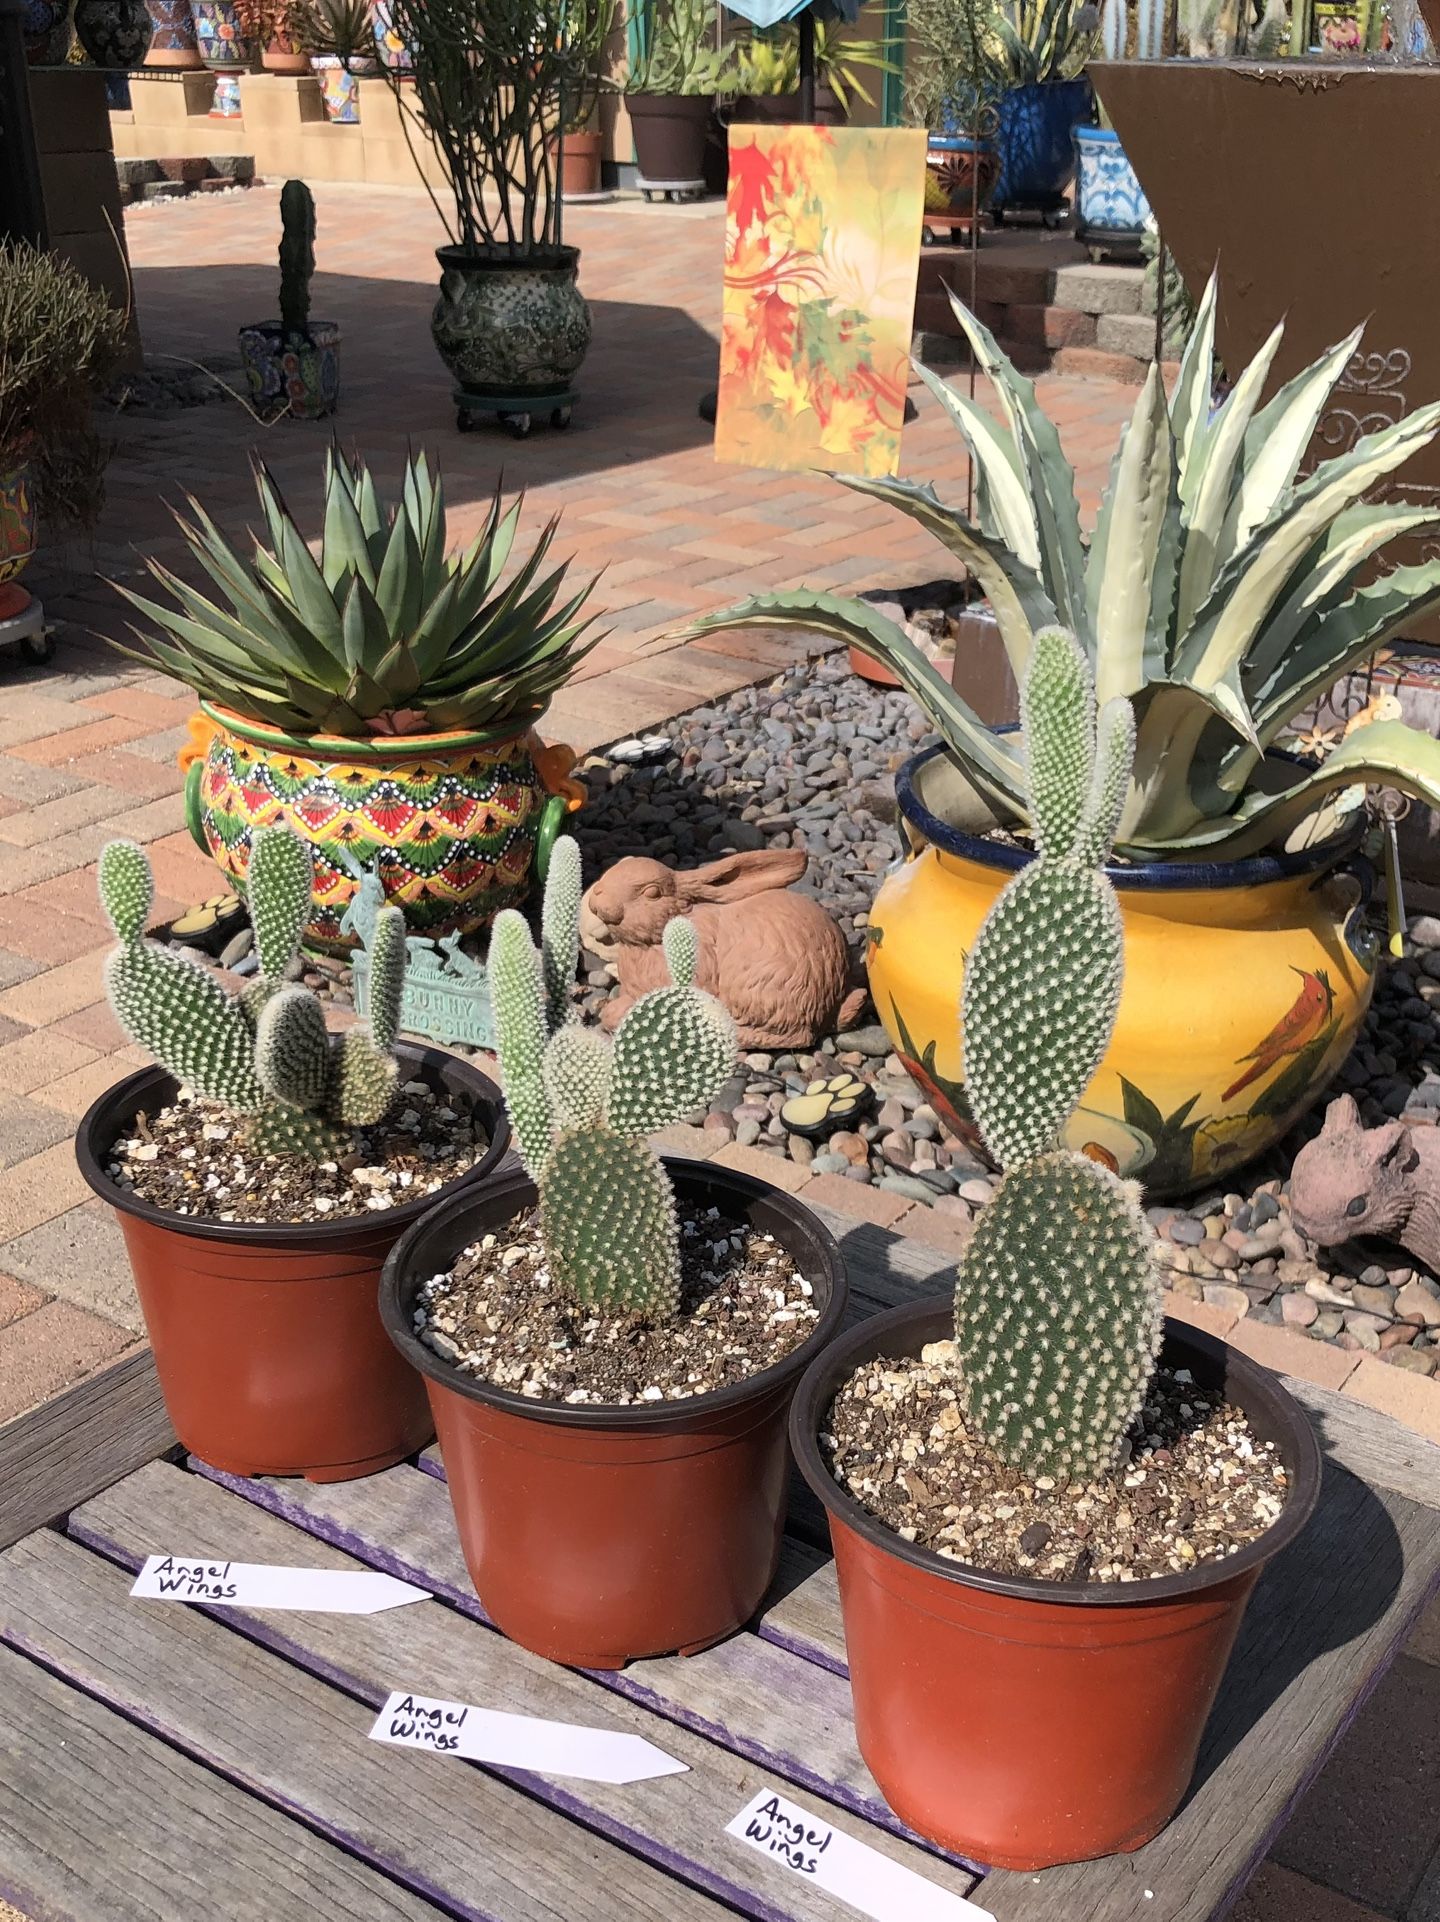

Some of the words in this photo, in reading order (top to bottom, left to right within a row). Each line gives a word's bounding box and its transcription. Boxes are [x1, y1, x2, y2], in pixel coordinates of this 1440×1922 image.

[405, 988, 474, 1018] BUNNY
[153, 1557, 231, 1583] Angel
[159, 1575, 237, 1599] Wings
[393, 1696, 468, 1729] Angel
[390, 1720, 459, 1750] Wings
[756, 1797, 832, 1853] Angel
[745, 1818, 818, 1873] Wings
